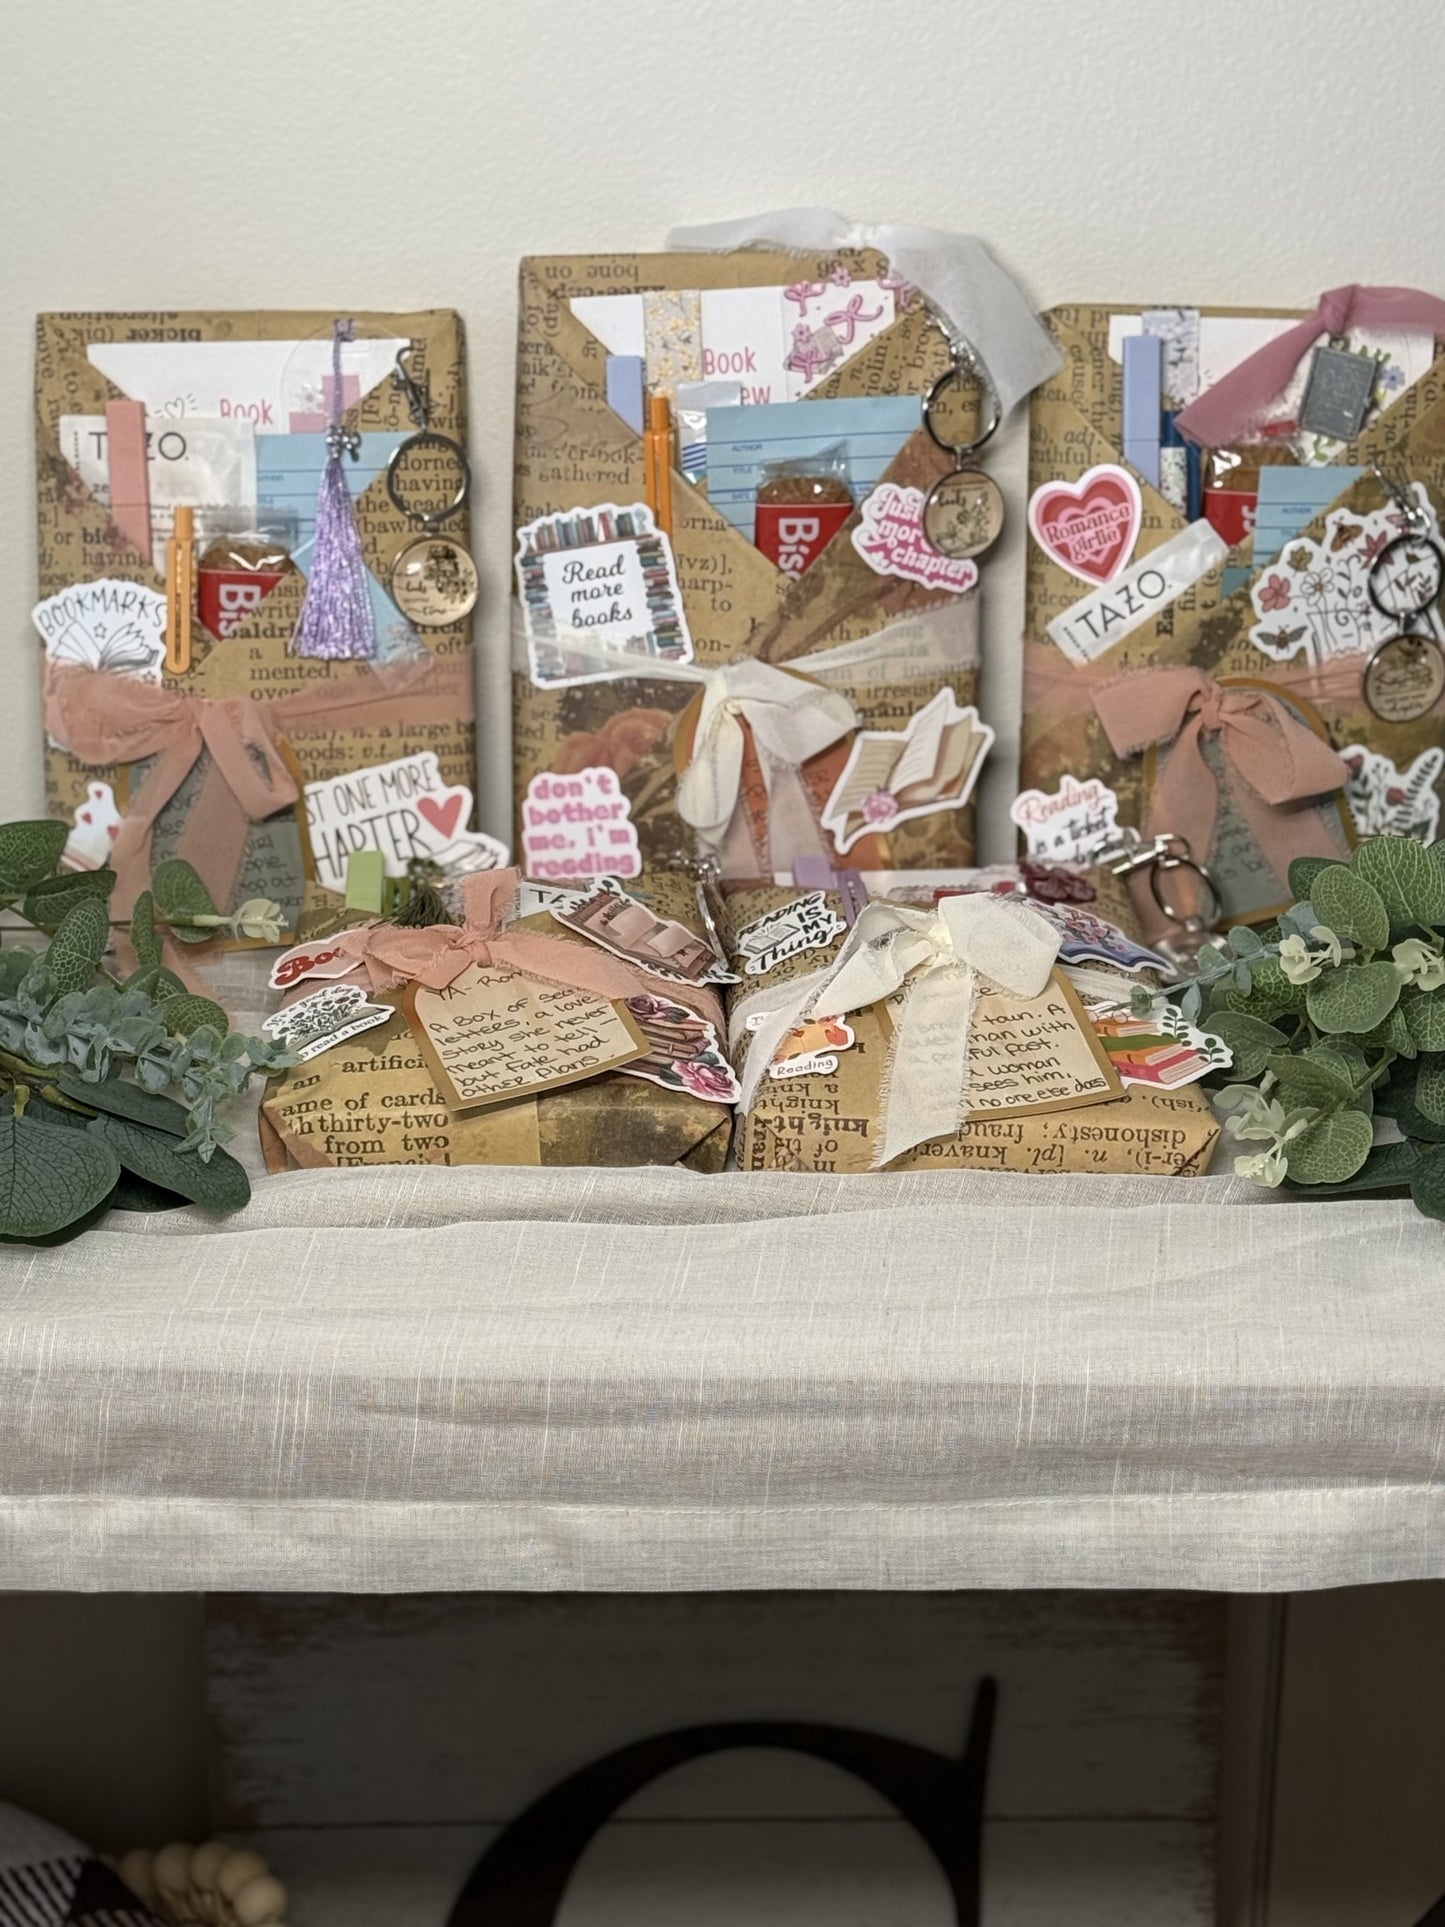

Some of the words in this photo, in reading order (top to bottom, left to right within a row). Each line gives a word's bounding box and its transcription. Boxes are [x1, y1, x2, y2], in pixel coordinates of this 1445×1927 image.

[703, 346, 757, 375] Book
[219, 398, 274, 425] Book
[1045, 504, 1131, 545] Romance
[1071, 528, 1121, 562] girlie
[562, 553, 626, 585] Read
[889, 544, 976, 585] chapter
[570, 582, 625, 604] more
[37, 586, 169, 638] BOOKMARKS
[571, 602, 633, 629] books
[333, 775, 378, 817] ONE
[378, 758, 438, 805] MORE
[533, 774, 613, 799] don't
[528, 802, 625, 827] bother
[1018, 780, 1114, 824] Reading
[531, 852, 635, 877] reading
[738, 894, 823, 941] READING
[797, 907, 822, 923] IS
[803, 913, 834, 935] MY
[758, 928, 835, 971] Thing
[534, 1010, 553, 1020] a
[554, 994, 598, 1013] love
[1047, 1003, 1068, 1018] A
[310, 1033, 339, 1053] read
[340, 1029, 350, 1038] a
[350, 1014, 384, 1032] book
[429, 1022, 449, 1033] A
[441, 1038, 505, 1061] story
[508, 1027, 550, 1043] she
[554, 1005, 609, 1030] never
[1020, 1021, 1076, 1039] with
[445, 1050, 517, 1075] meant
[524, 1042, 550, 1053] to
[553, 1025, 599, 1043] tell
[454, 1068, 500, 1088] but
[556, 1034, 612, 1056] had
[776, 1059, 835, 1077] Reading
[987, 1056, 1062, 1076] woman
[1023, 1068, 1072, 1087] him,
[344, 1091, 371, 1111] of
[380, 1087, 448, 1108] cards
[979, 1097, 1001, 1108] no
[1006, 1091, 1038, 1105] one
[1037, 1087, 1070, 1100] else
[1074, 1076, 1109, 1093] does
[317, 1112, 450, 1135] thirty-two
[957, 1122, 1025, 1144] fraud
[323, 1134, 386, 1155] from
[401, 1133, 451, 1152] two
[812, 1139, 839, 1158] of
[1043, 1126, 1188, 1150] dishonesty;
